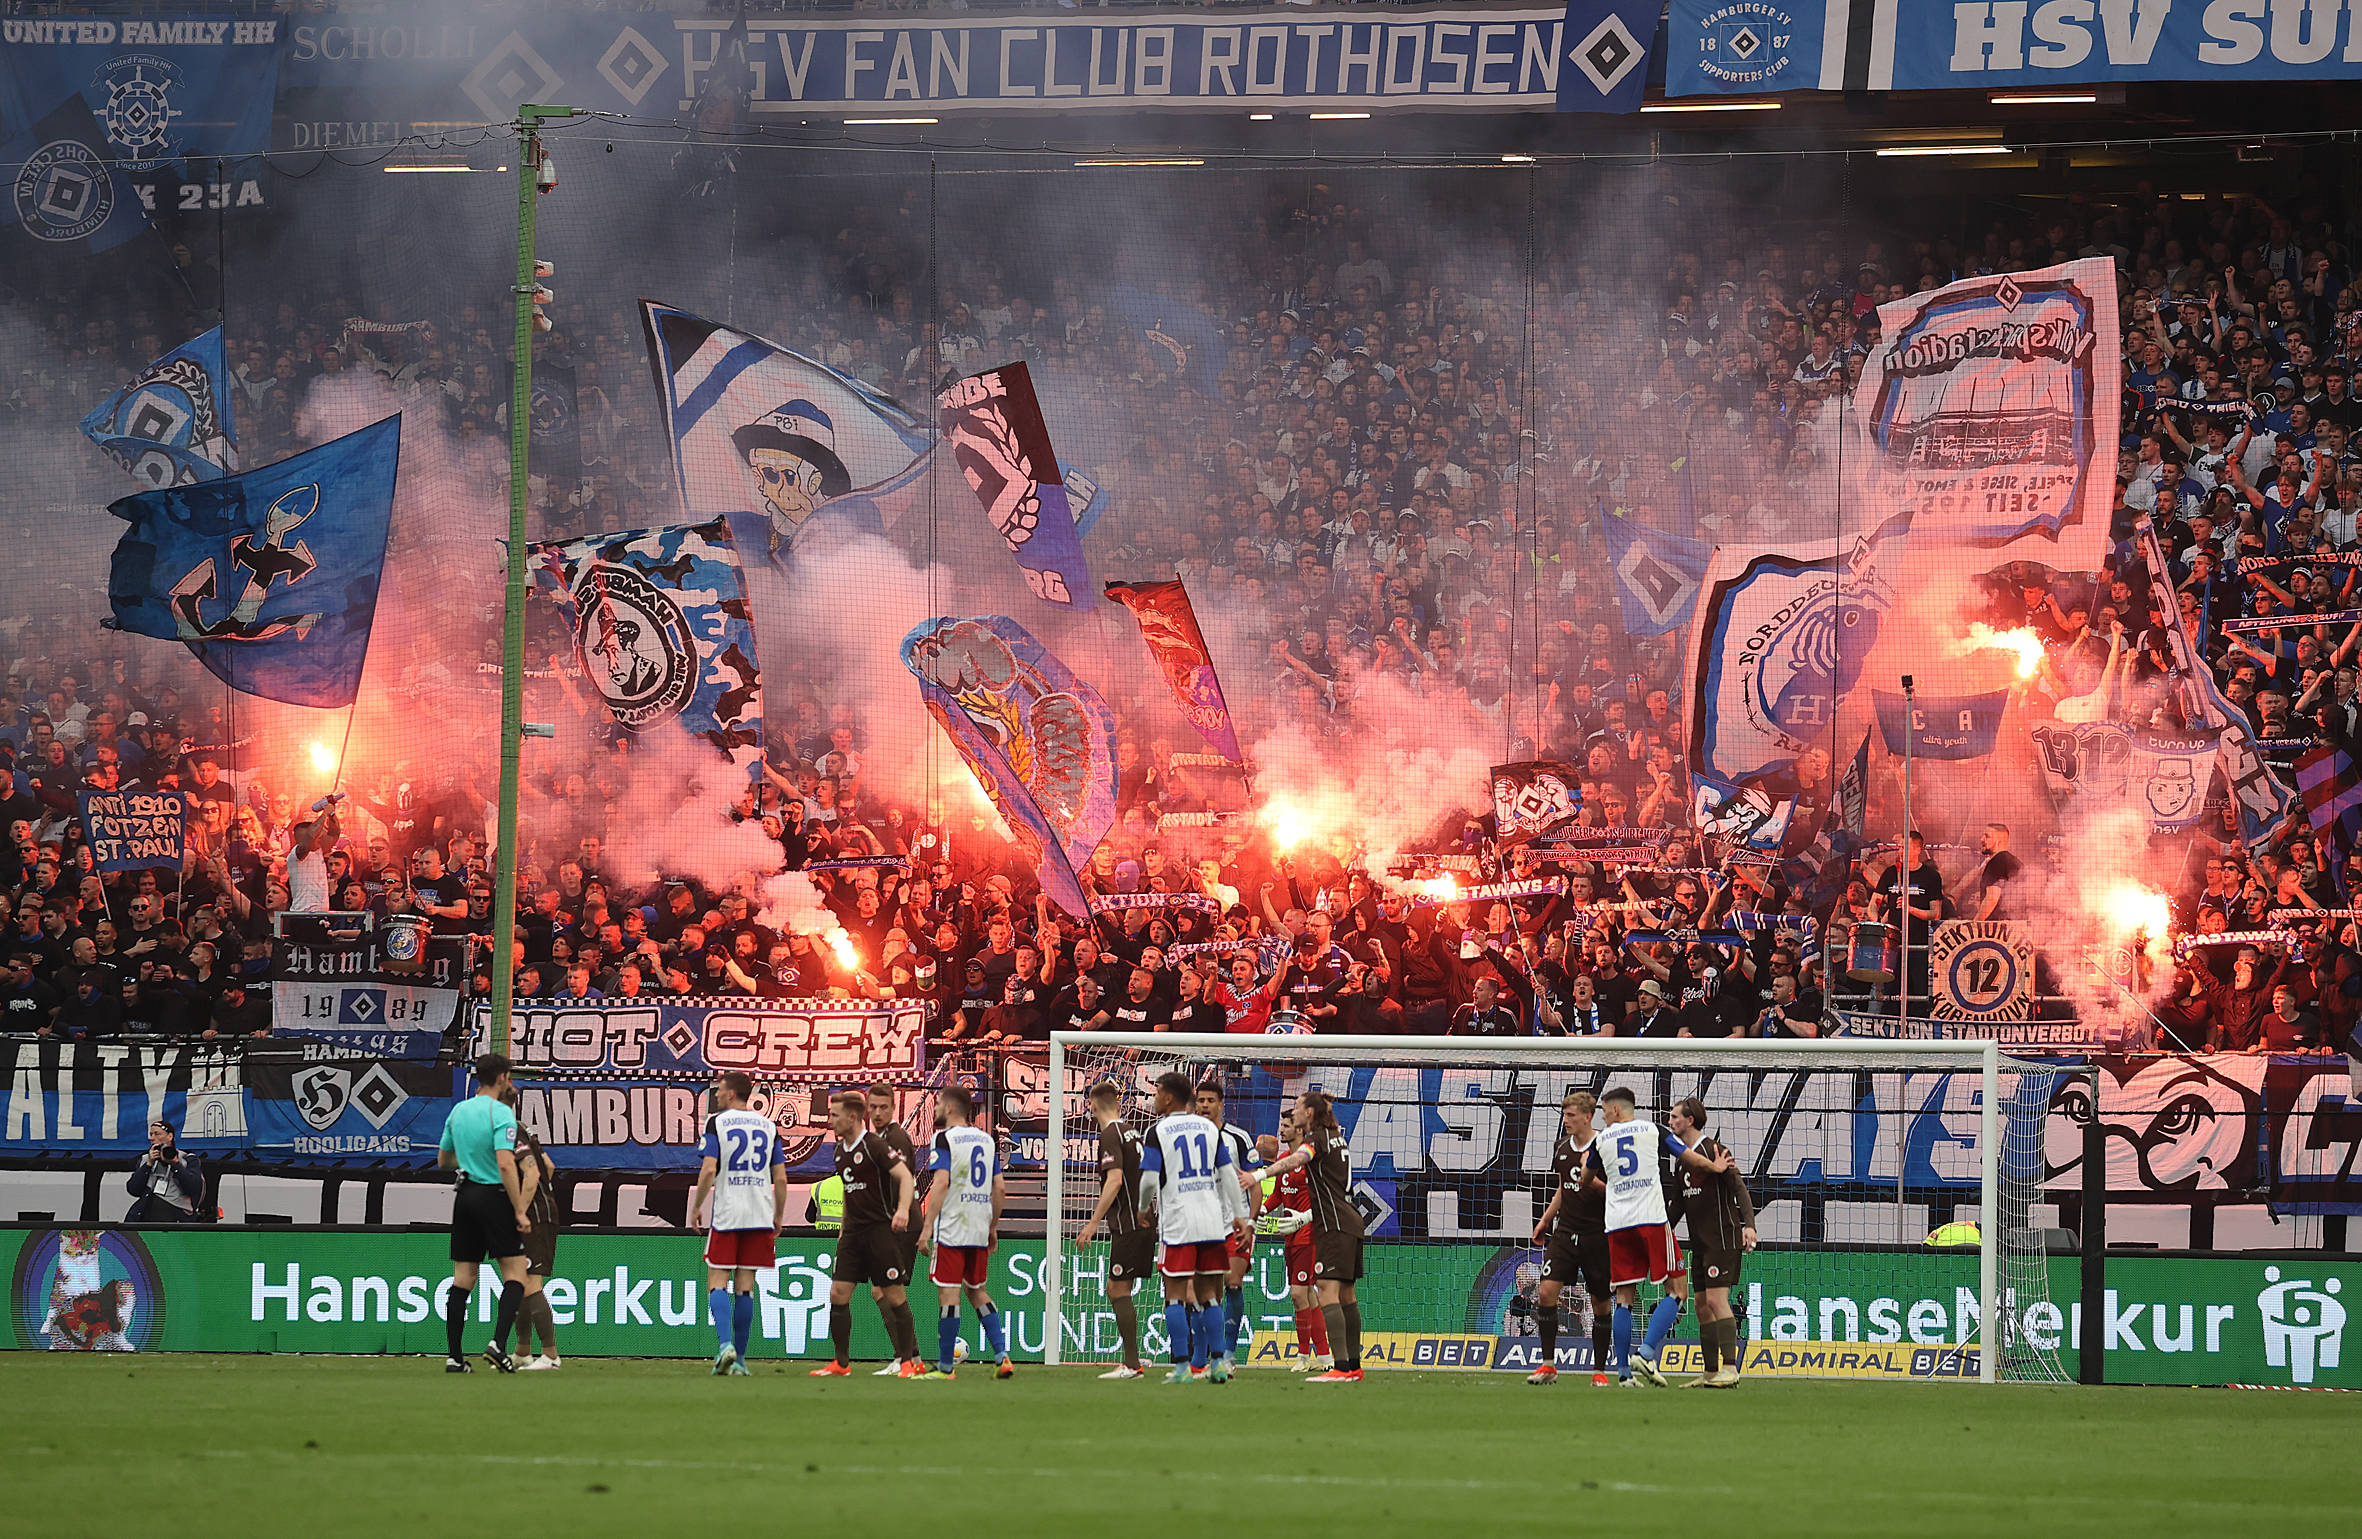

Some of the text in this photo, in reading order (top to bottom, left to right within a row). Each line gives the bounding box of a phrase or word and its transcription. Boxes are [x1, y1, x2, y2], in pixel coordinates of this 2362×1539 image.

[1700, 3, 1792, 29] HAMBURGER SV
[2, 20, 278, 45] UNITED FAMILY HH
[1700, 35, 1790, 51] 18 87
[1950, 0, 2362, 72] HSV SU
[105, 56, 172, 71] United Family HH
[845, 31, 970, 100] FAN
[999, 27, 1172, 98] CLUB
[1203, 22, 1563, 95] ROTHOSEN
[1698, 56, 1790, 82] SUPPORTERS CLUB
[178, 180, 265, 210] 23A
[2237, 555, 2280, 576] NORD
[2032, 725, 2132, 784] 1312
[2149, 736, 2206, 750] turn up
[128, 795, 182, 816] 1910
[90, 815, 182, 838] FOTZEN
[1932, 921, 2013, 961] SEKTION
[1964, 958, 2000, 996] 12
[302, 993, 429, 1022] 19 89
[702, 1008, 924, 1073] CREW
[1850, 1016, 2098, 1044] SEKTION STADIONVERBOT
[6, 1044, 181, 1140] ALTY
[293, 1135, 411, 1154] HOOLIGANS
[726, 1128, 769, 1173] 23
[1173, 1133, 1213, 1180] 11
[1616, 1135, 1639, 1177] 5
[970, 1145, 987, 1188] 6
[727, 1176, 765, 1187] MEFFERT
[1417, 1341, 1490, 1364] BET
[1747, 1348, 1904, 1374] ADMIRAL
